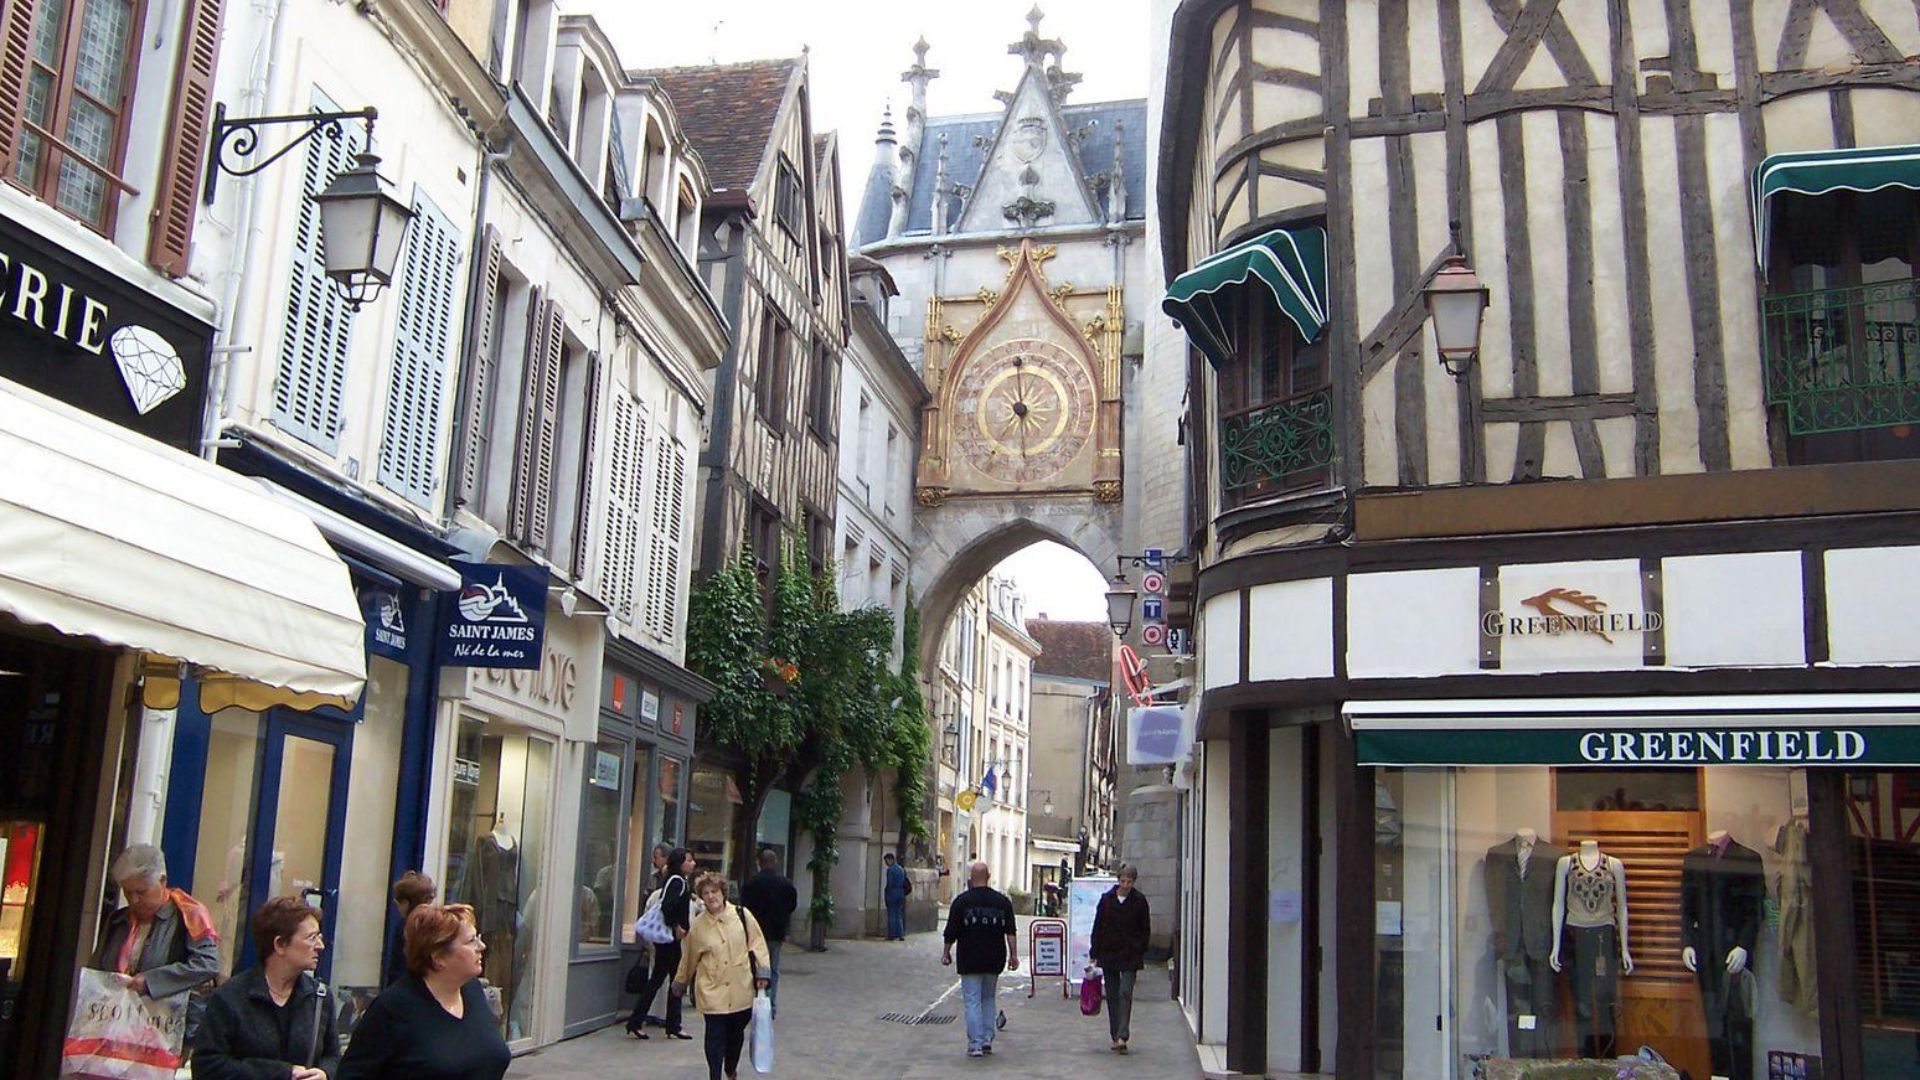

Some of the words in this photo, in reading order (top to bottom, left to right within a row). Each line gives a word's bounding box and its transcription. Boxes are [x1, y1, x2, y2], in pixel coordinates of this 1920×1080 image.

[449, 624, 491, 638] SAINT
[491, 626, 535, 641] JAMES
[1482, 609, 1663, 637] GREENFIELD
[454, 644, 470, 657] Né
[471, 644, 485, 656] de
[487, 644, 499, 657] la
[503, 651, 524, 659] mer
[1579, 730, 1866, 761] GREENFIELD
